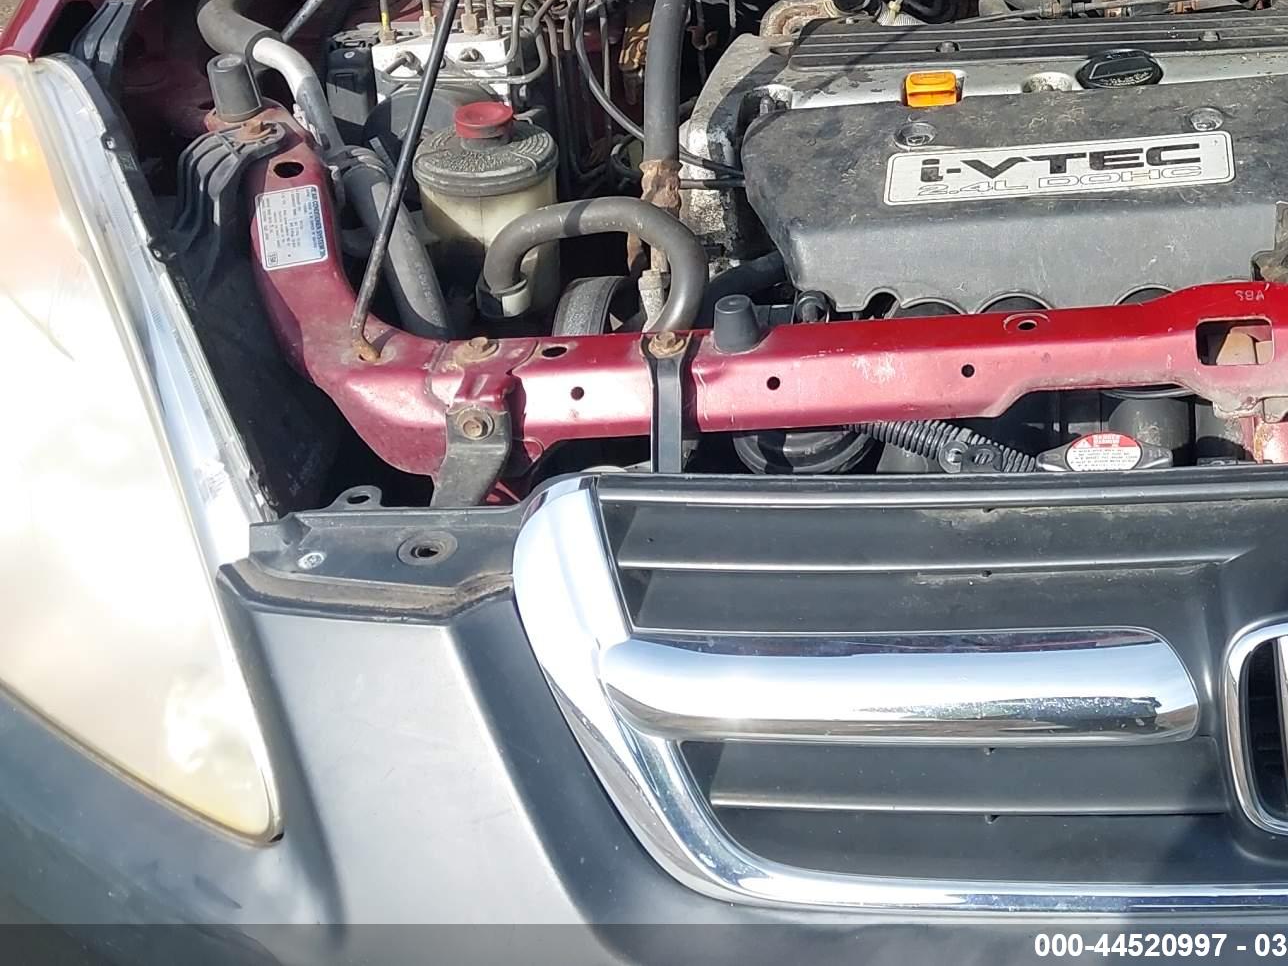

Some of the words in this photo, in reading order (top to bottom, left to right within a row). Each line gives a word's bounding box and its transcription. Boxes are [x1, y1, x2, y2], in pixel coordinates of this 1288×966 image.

[920, 143, 1201, 183] i-VTEC
[917, 178, 1028, 197] 2.4L
[1038, 166, 1202, 189] DOHC
